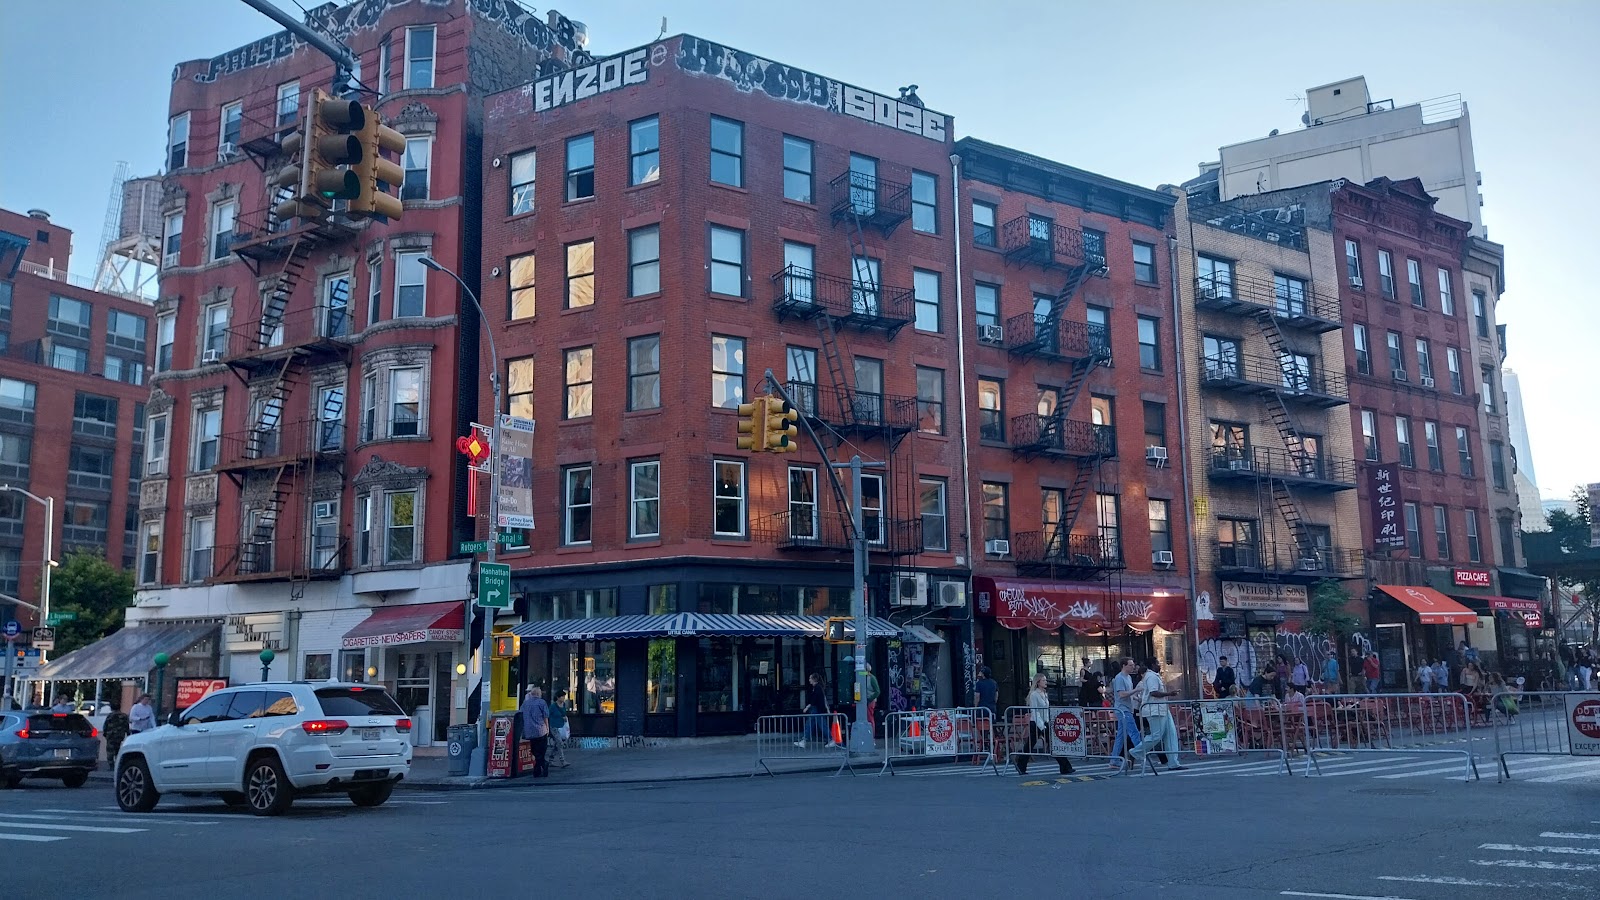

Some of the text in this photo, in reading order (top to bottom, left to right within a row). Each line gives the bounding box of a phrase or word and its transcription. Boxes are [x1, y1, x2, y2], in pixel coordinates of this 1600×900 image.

[498, 534, 516, 543] Canal
[461, 542, 481, 552] Rutgers
[481, 567, 509, 577] Manhattan
[1457, 571, 1488, 582] PIZZA CAFE
[485, 577, 504, 587] Bridge
[1277, 585, 1282, 596] &
[1524, 613, 1540, 621] PIZZA
[343, 630, 426, 647] CIGARETTES NEWSPAPERS
